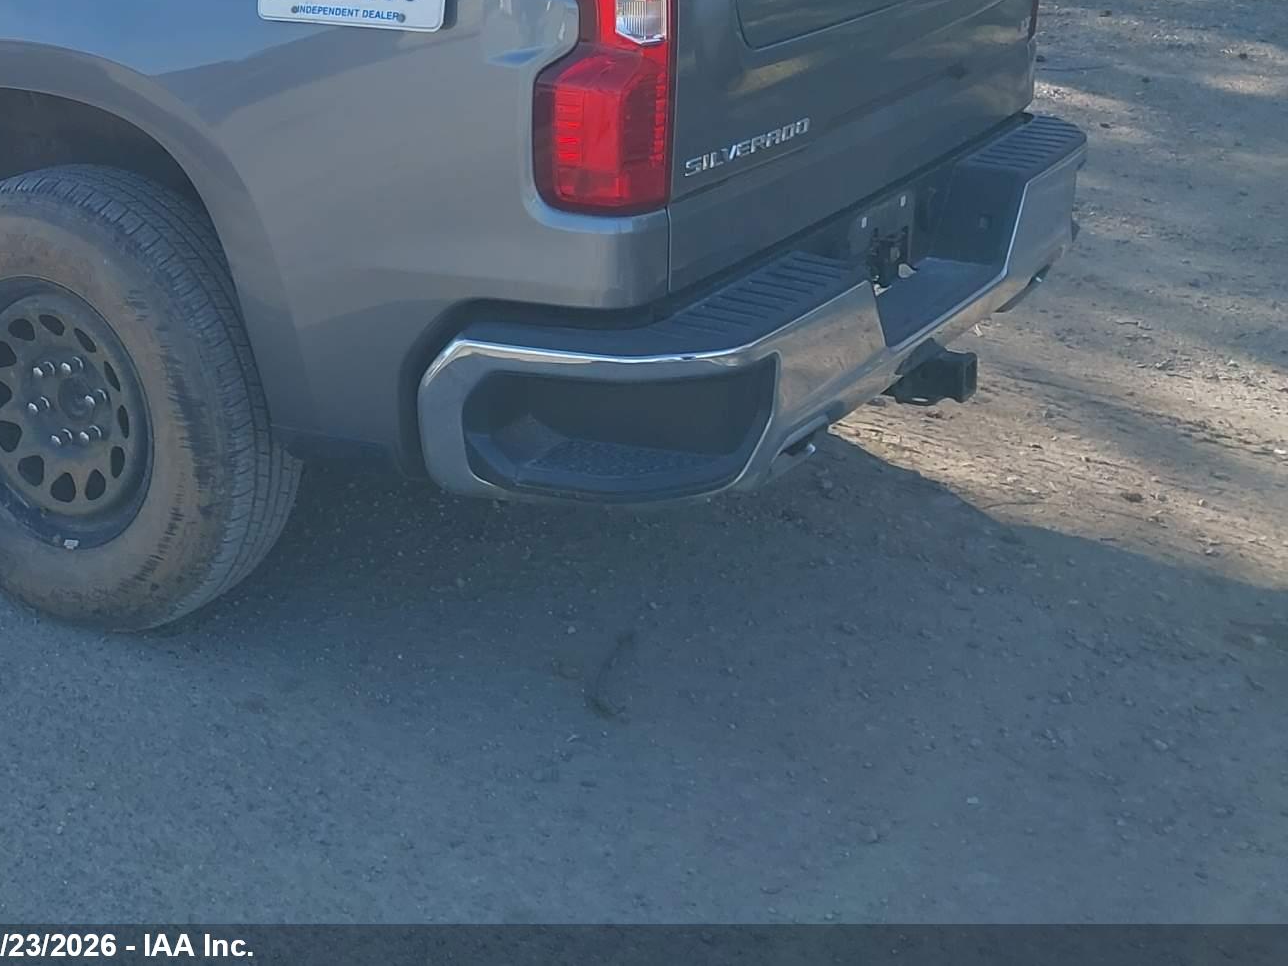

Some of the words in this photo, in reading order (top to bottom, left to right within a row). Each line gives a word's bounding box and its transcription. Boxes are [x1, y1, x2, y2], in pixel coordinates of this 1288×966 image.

[297, 5, 360, 18] INDEPENDENT
[361, 9, 399, 21] DEALER
[684, 117, 810, 177] SILVERADO
